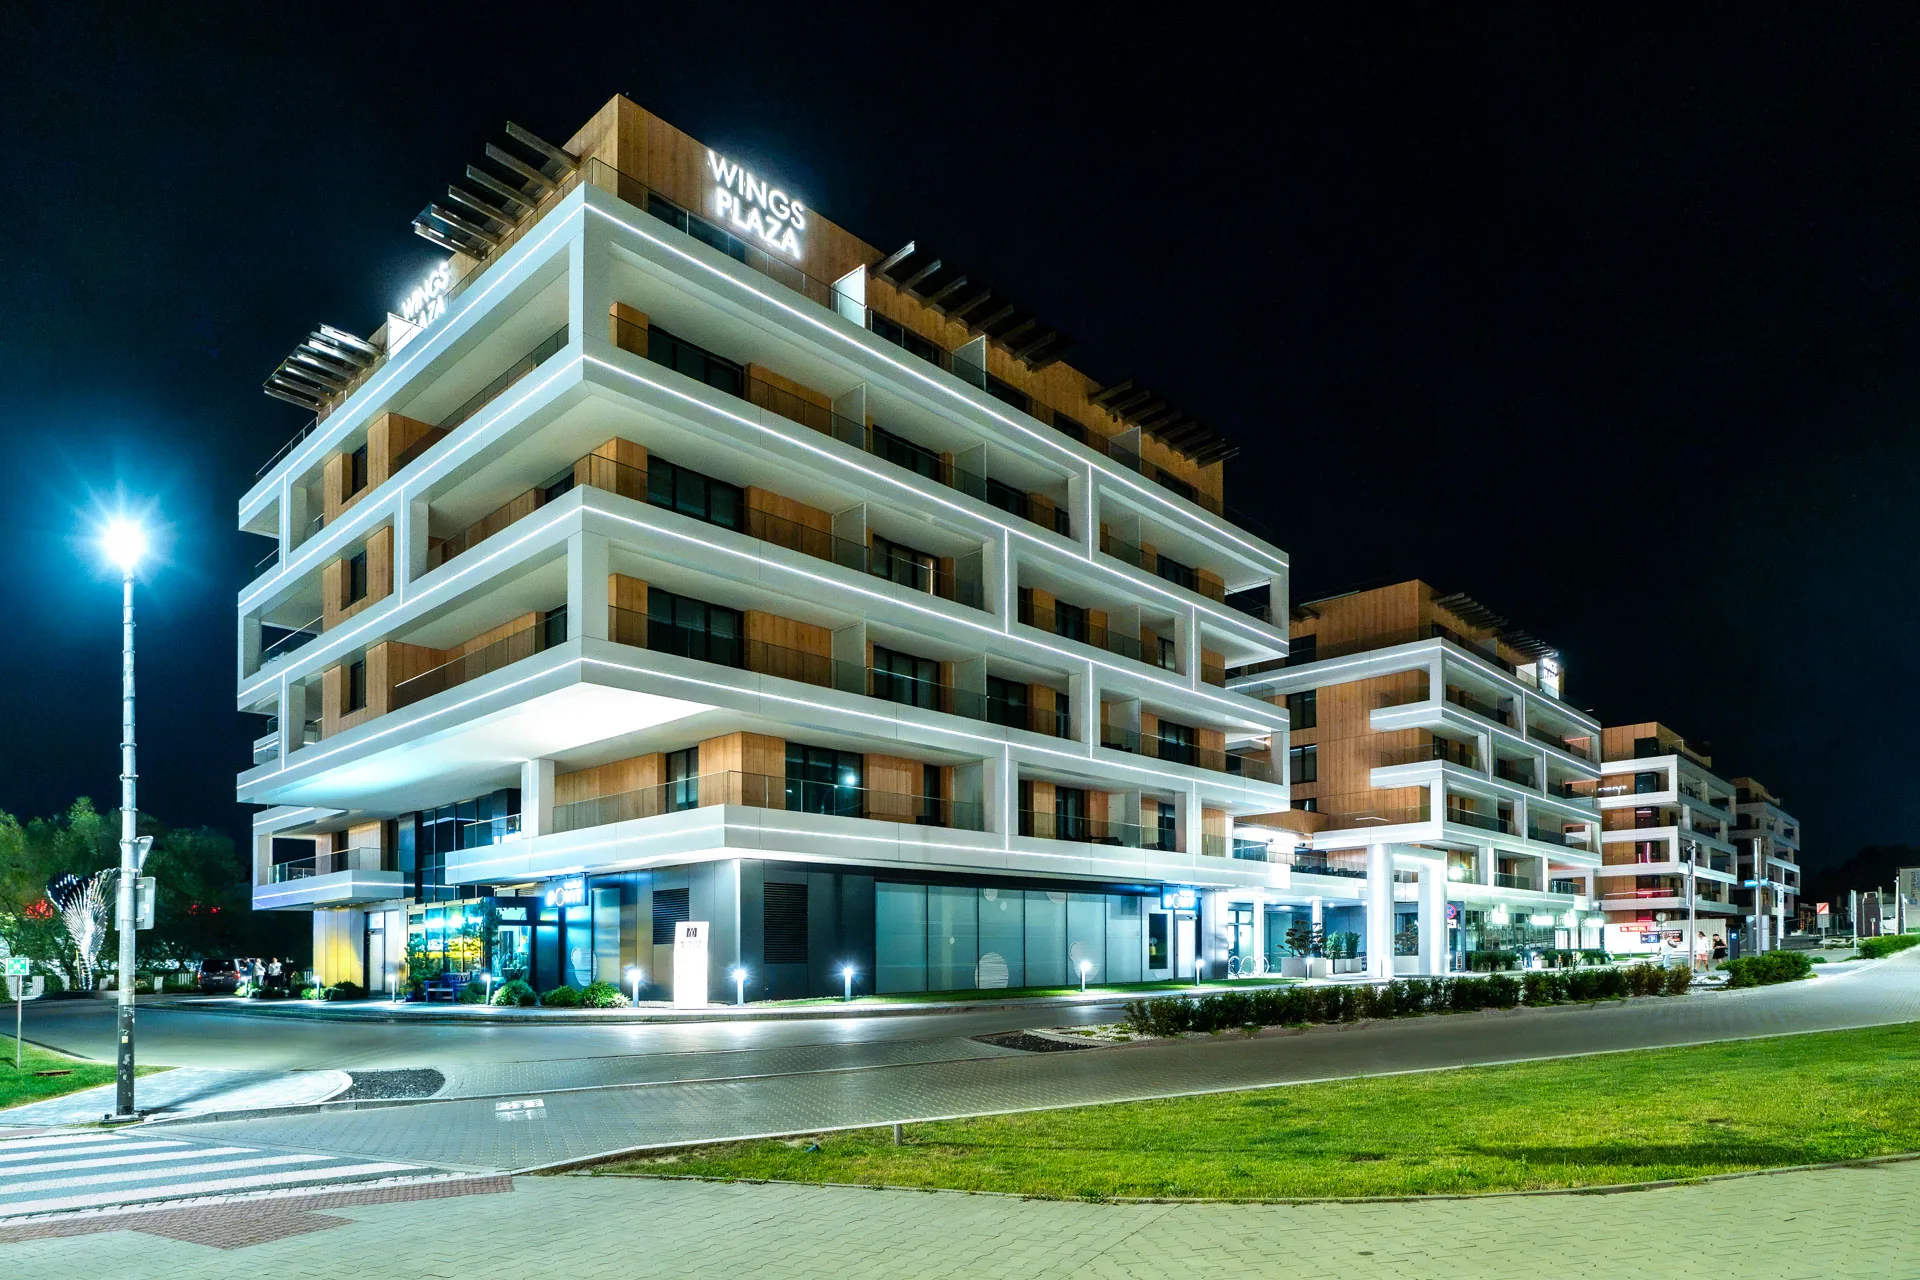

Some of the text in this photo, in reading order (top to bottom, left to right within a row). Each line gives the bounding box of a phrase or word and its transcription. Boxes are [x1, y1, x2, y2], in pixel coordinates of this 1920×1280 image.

[708, 150, 804, 230] WINGS
[715, 186, 800, 259] PLAZA
[401, 260, 449, 320] WINGS
